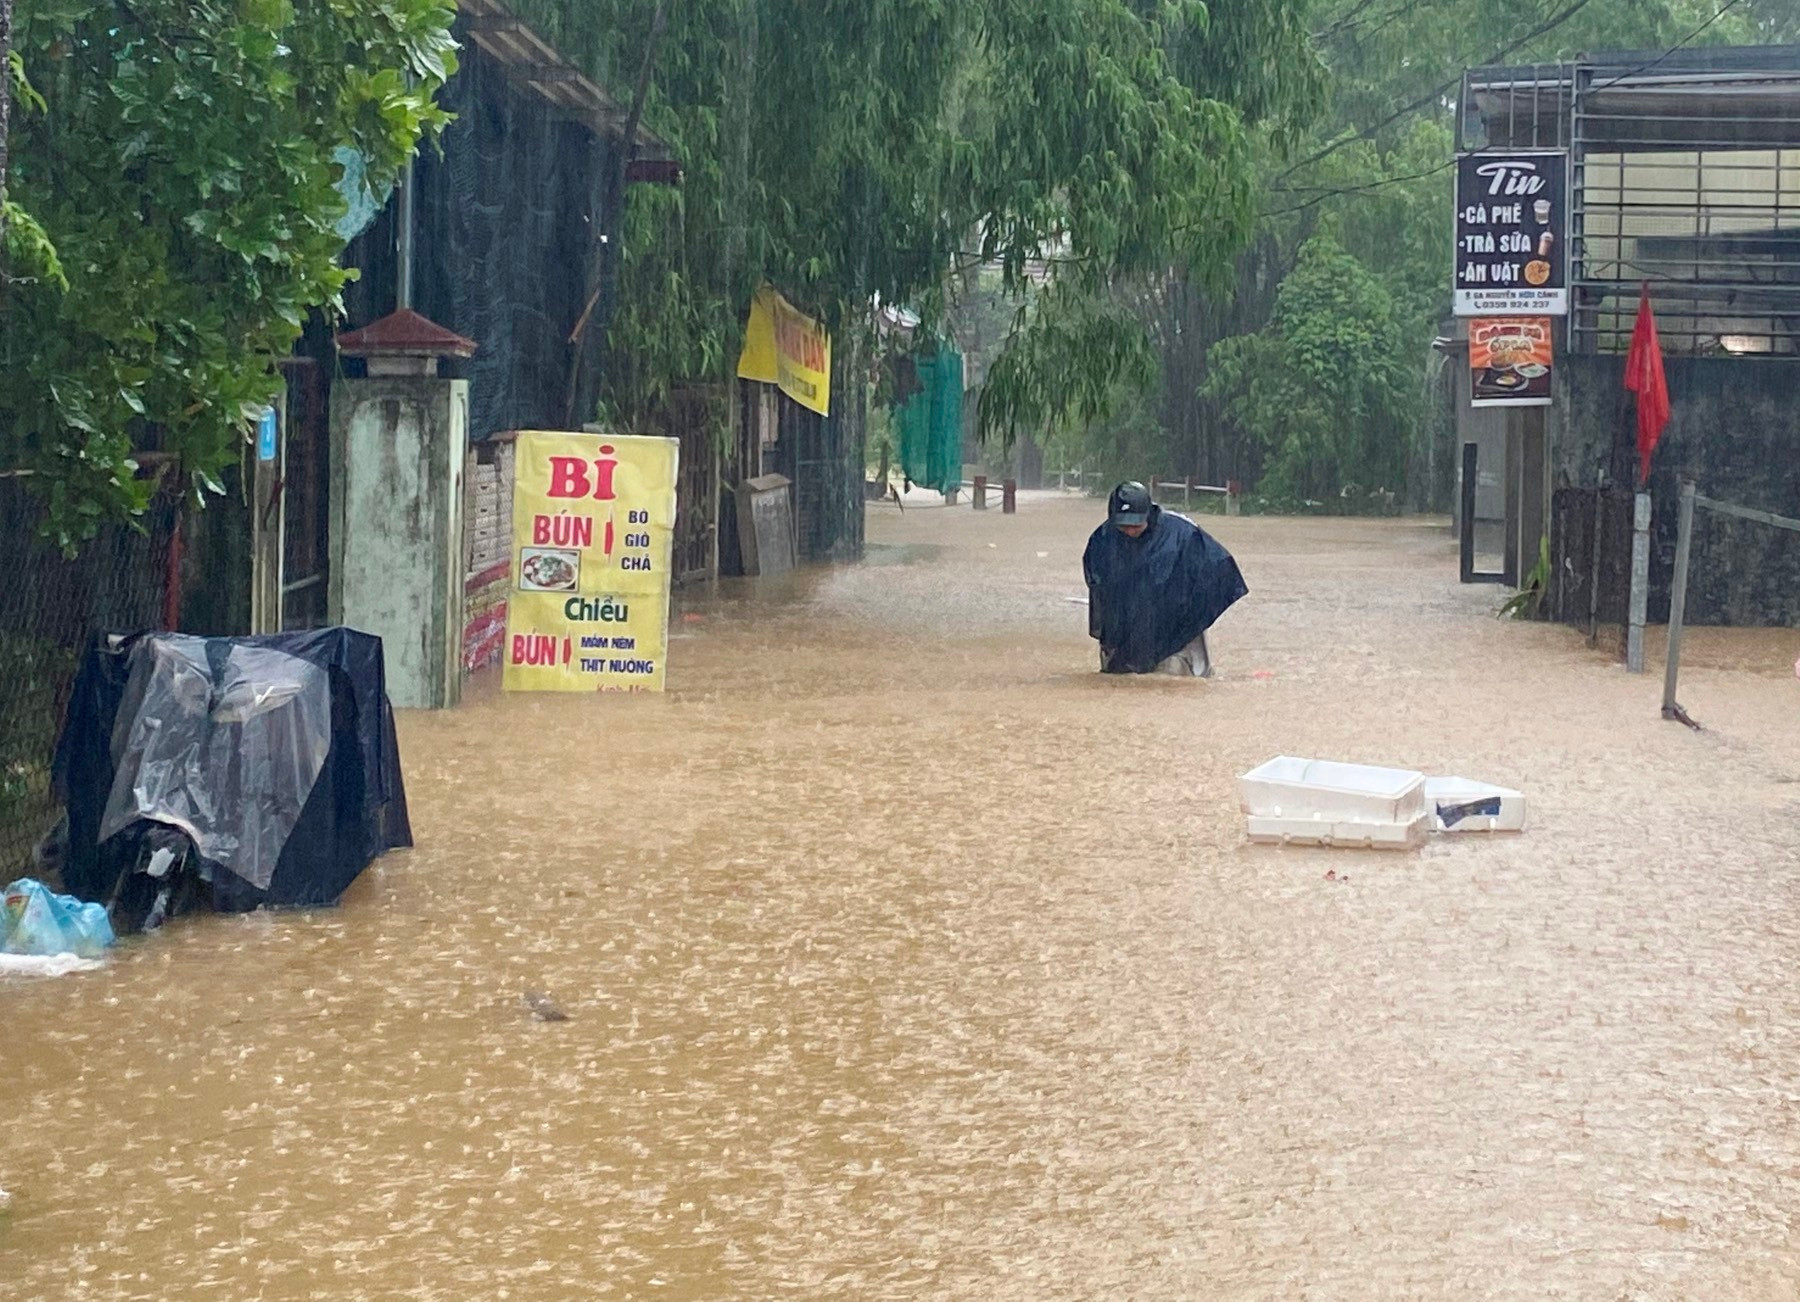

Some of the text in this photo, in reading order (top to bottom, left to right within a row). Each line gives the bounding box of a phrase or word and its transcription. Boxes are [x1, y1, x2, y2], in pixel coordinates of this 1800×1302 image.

[1476, 161, 1546, 195] Tin
[1465, 202, 1522, 224] CÀ PHÊ
[1465, 231, 1532, 253] TRÀ SỮA
[1465, 261, 1520, 286] ĂN VẬT
[533, 509, 593, 547] BÚN
[625, 531, 650, 547] GIÒ
[621, 553, 651, 571] CHẢ
[512, 628, 557, 666] BÚN
